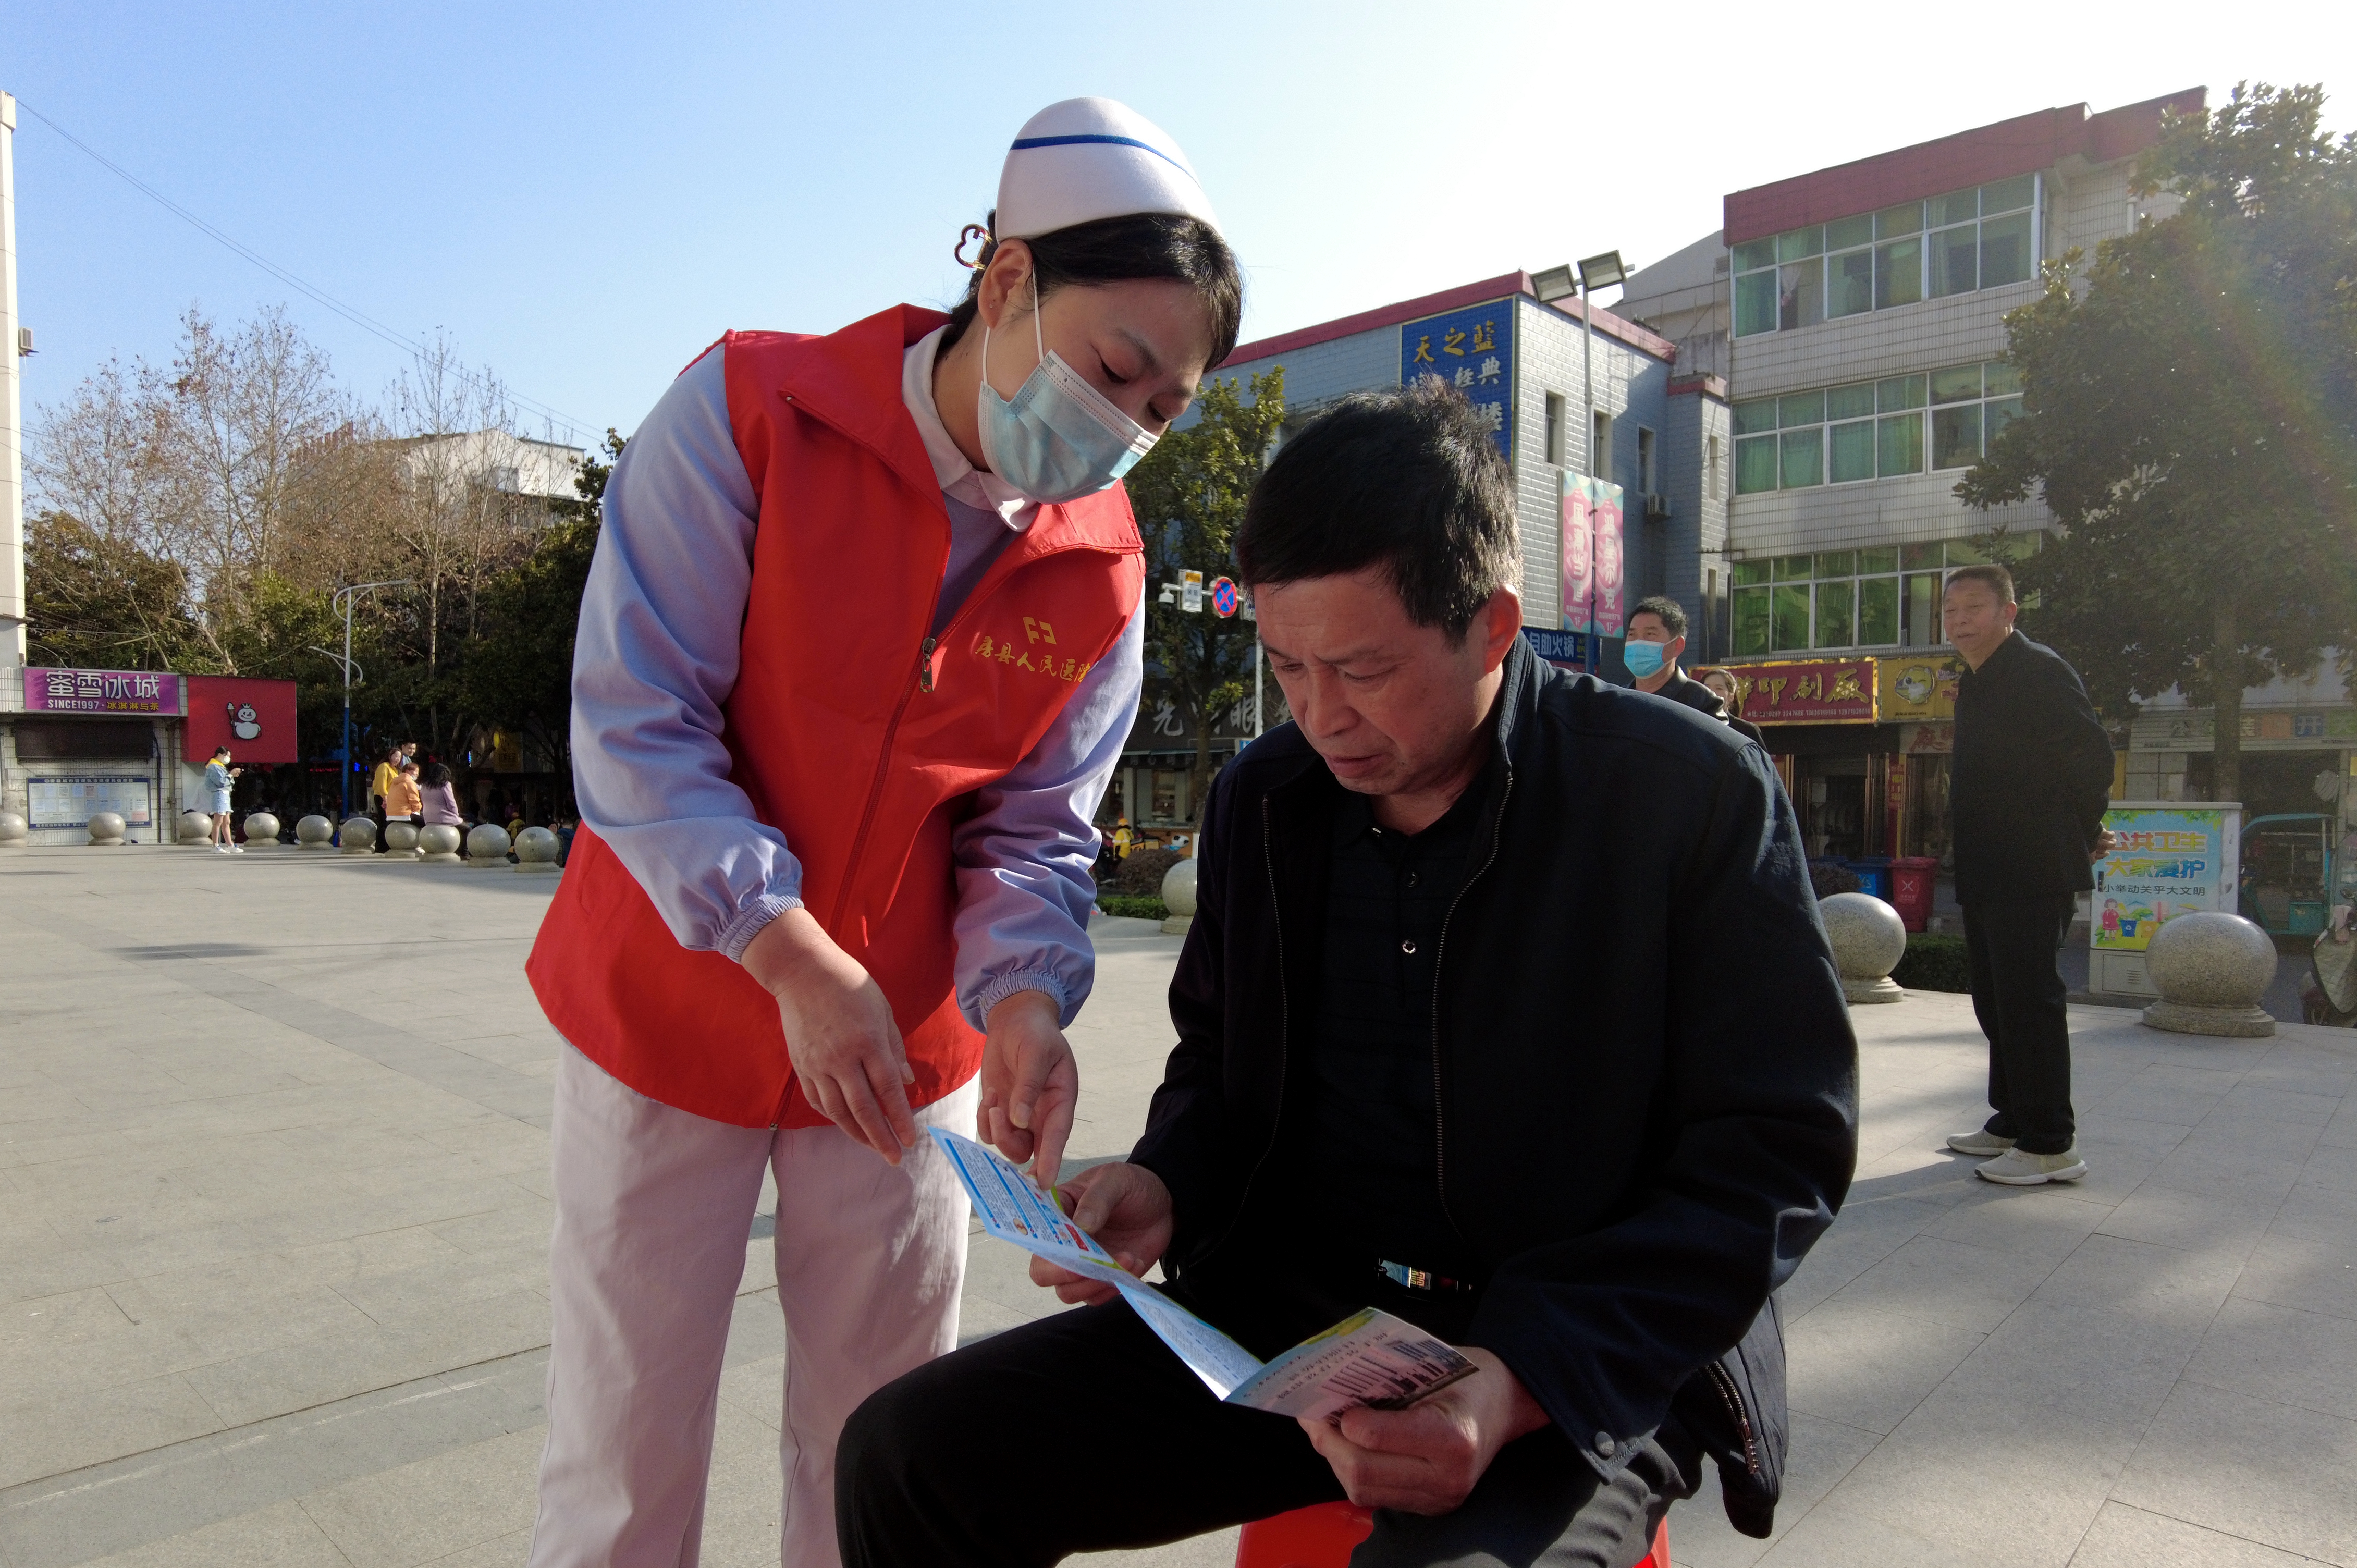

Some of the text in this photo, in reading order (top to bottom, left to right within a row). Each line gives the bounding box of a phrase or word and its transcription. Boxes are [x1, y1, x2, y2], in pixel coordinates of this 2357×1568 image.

[1574, 616, 1581, 626] 1F
[1606, 622, 1613, 632] 1F
[46, 670, 159, 700] 蜜雪冰城
[47, 699, 99, 710] SINCE1997
[2110, 831, 2206, 852] 公共卫生
[2105, 858, 2206, 879] 大家爱护
[2103, 884, 2206, 896] 小举动关乎大文明
